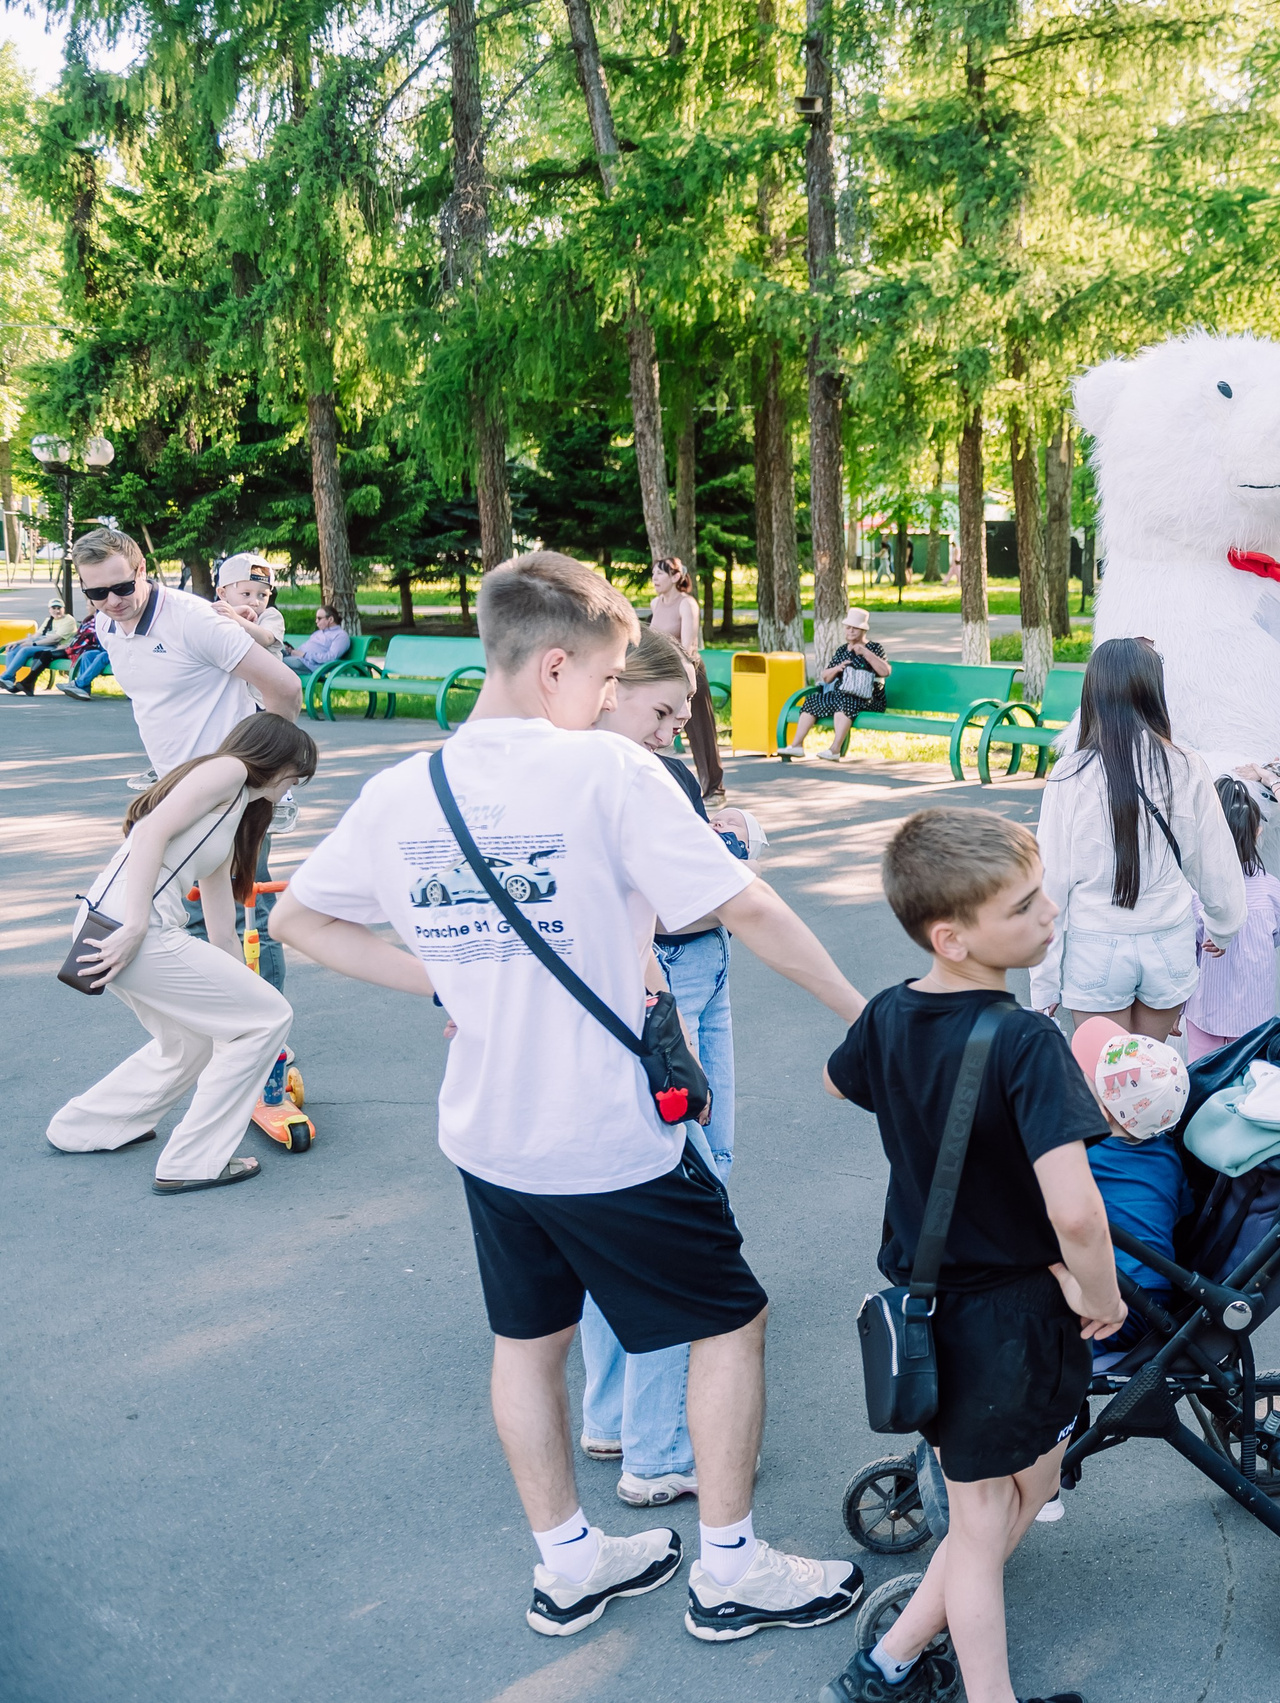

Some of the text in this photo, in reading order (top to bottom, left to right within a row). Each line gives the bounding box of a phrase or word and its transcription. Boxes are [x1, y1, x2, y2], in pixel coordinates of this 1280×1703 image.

[415, 924, 470, 938] Porsche
[537, 920, 564, 934] RS
[941, 1054, 982, 1172] LACOSTE
